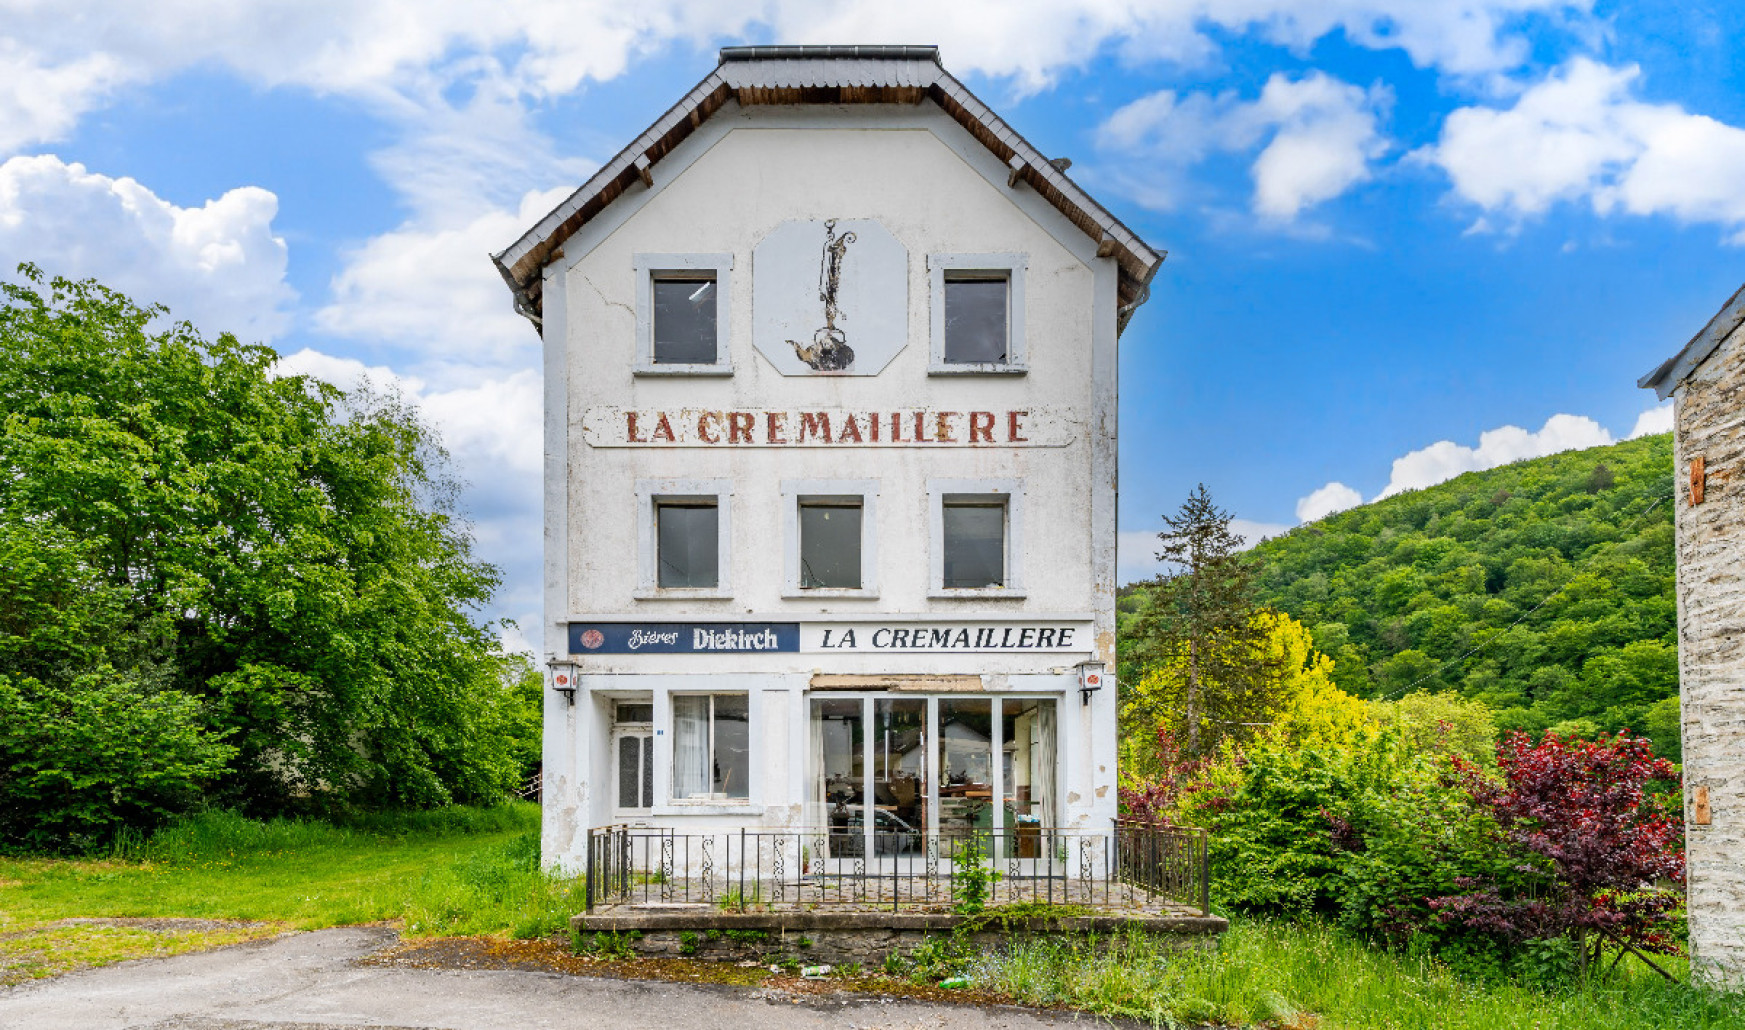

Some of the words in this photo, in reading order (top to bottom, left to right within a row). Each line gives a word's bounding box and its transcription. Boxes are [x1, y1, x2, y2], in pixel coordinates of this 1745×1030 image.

[626, 411, 676, 442] LA
[698, 411, 1028, 443] CREMAILLERE
[693, 628, 778, 649] Diekirch
[820, 629, 857, 648] LA
[871, 628, 1076, 648] CREMAILLERE
